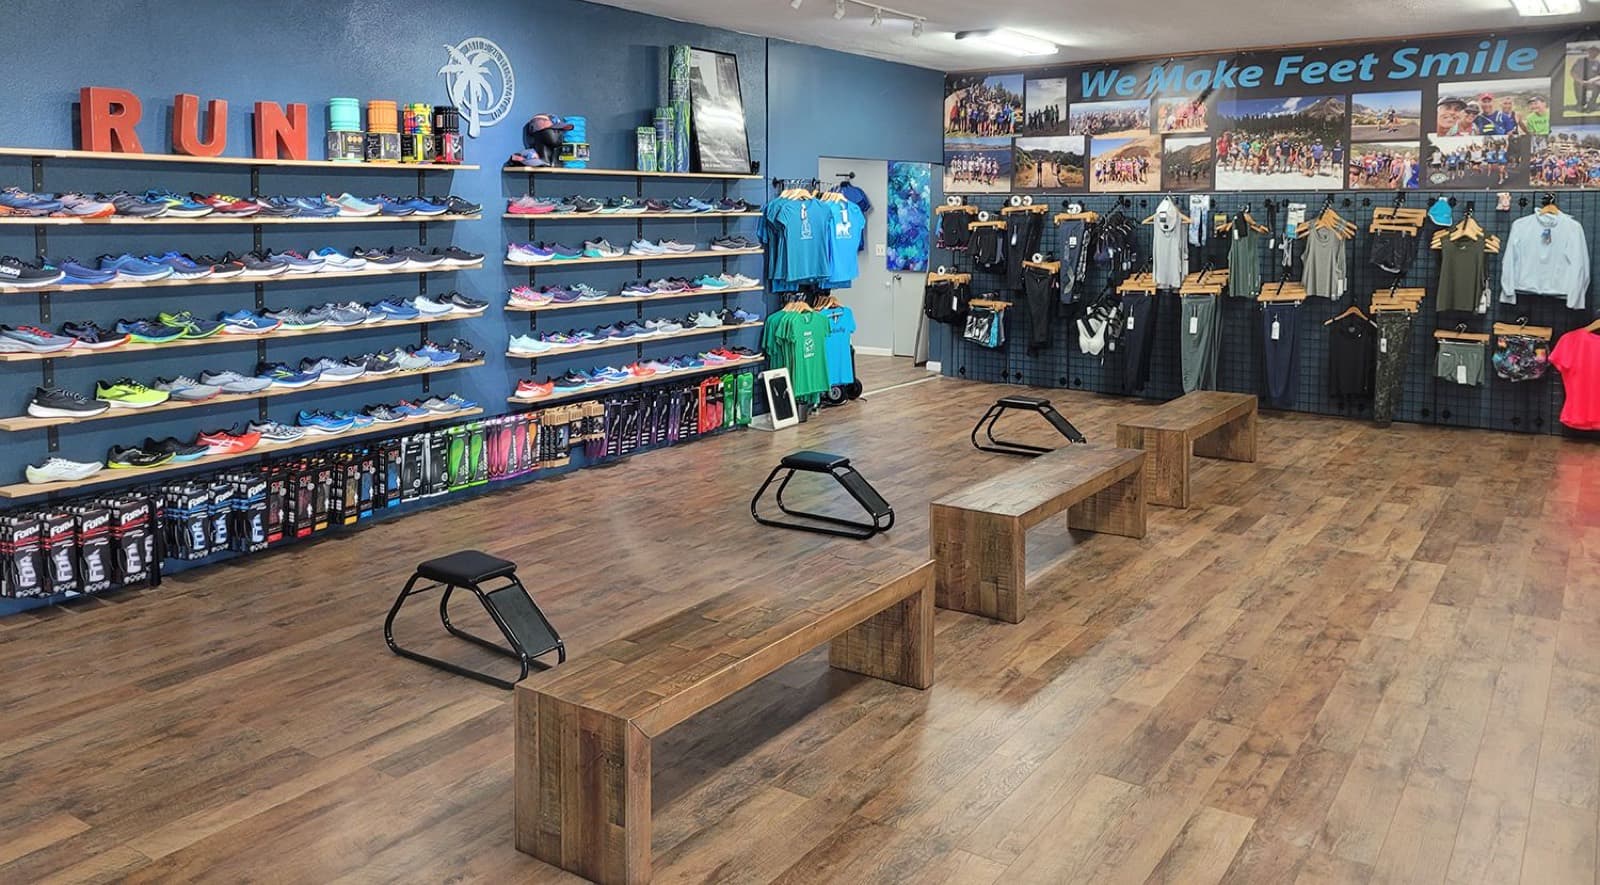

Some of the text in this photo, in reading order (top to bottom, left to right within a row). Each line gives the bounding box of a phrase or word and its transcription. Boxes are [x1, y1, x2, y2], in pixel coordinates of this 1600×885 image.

[1081, 40, 1538, 98] We Make Feet Smile
[79, 86, 307, 160] RUN
